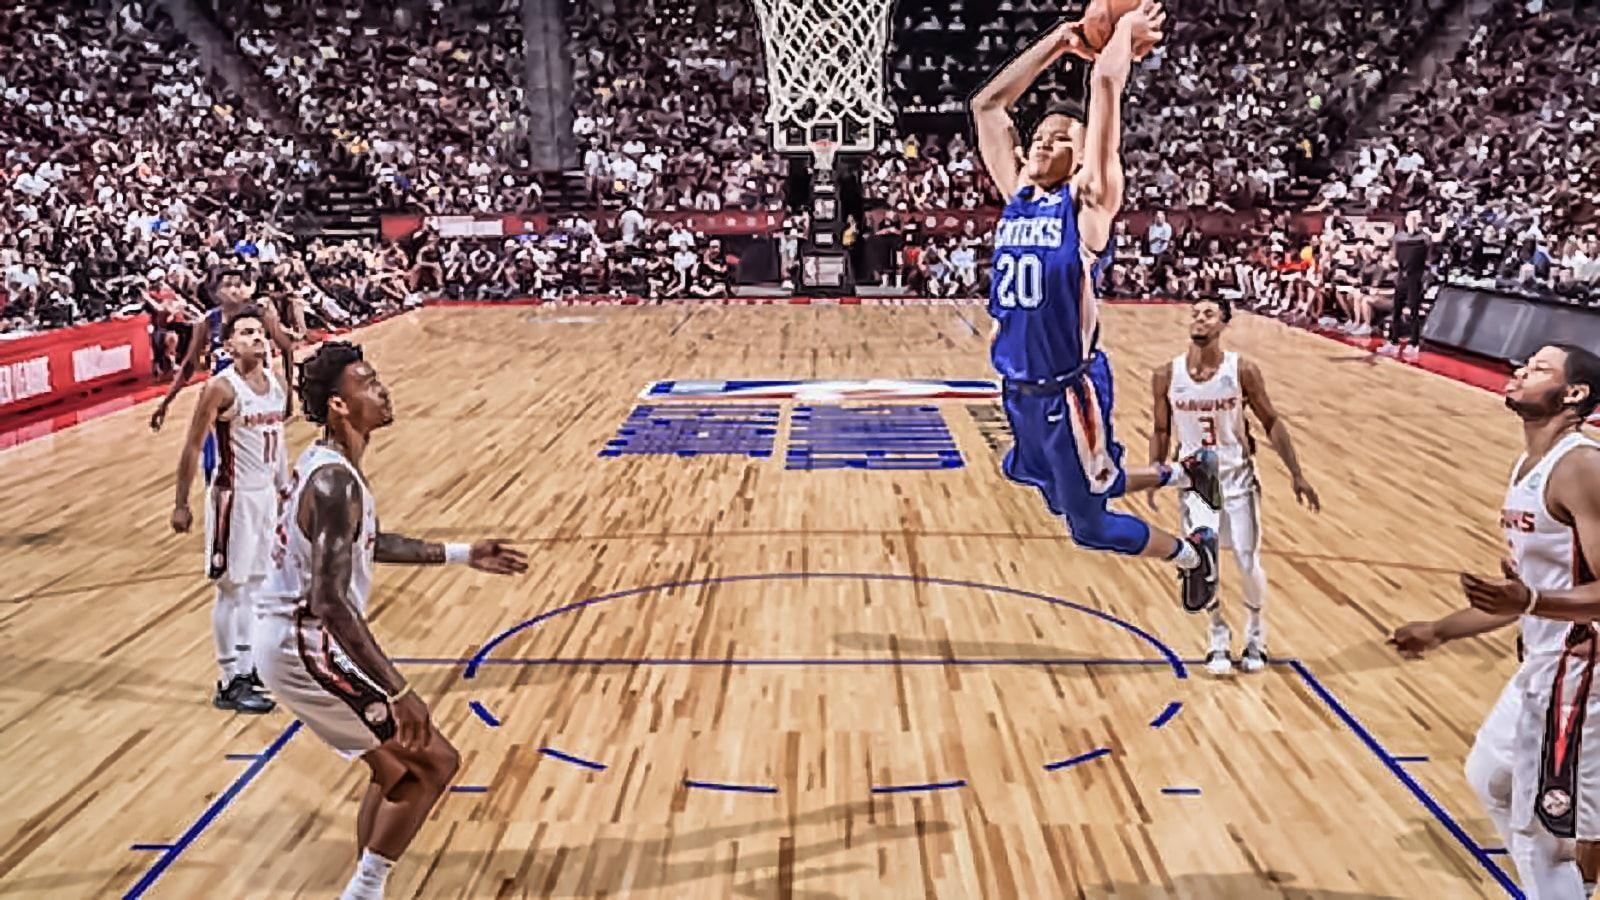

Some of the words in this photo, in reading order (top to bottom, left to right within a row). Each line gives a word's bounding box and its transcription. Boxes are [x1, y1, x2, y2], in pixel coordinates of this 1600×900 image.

[997, 253, 1042, 308] 20
[263, 430, 277, 463] 11
[1198, 416, 1216, 445] 3
